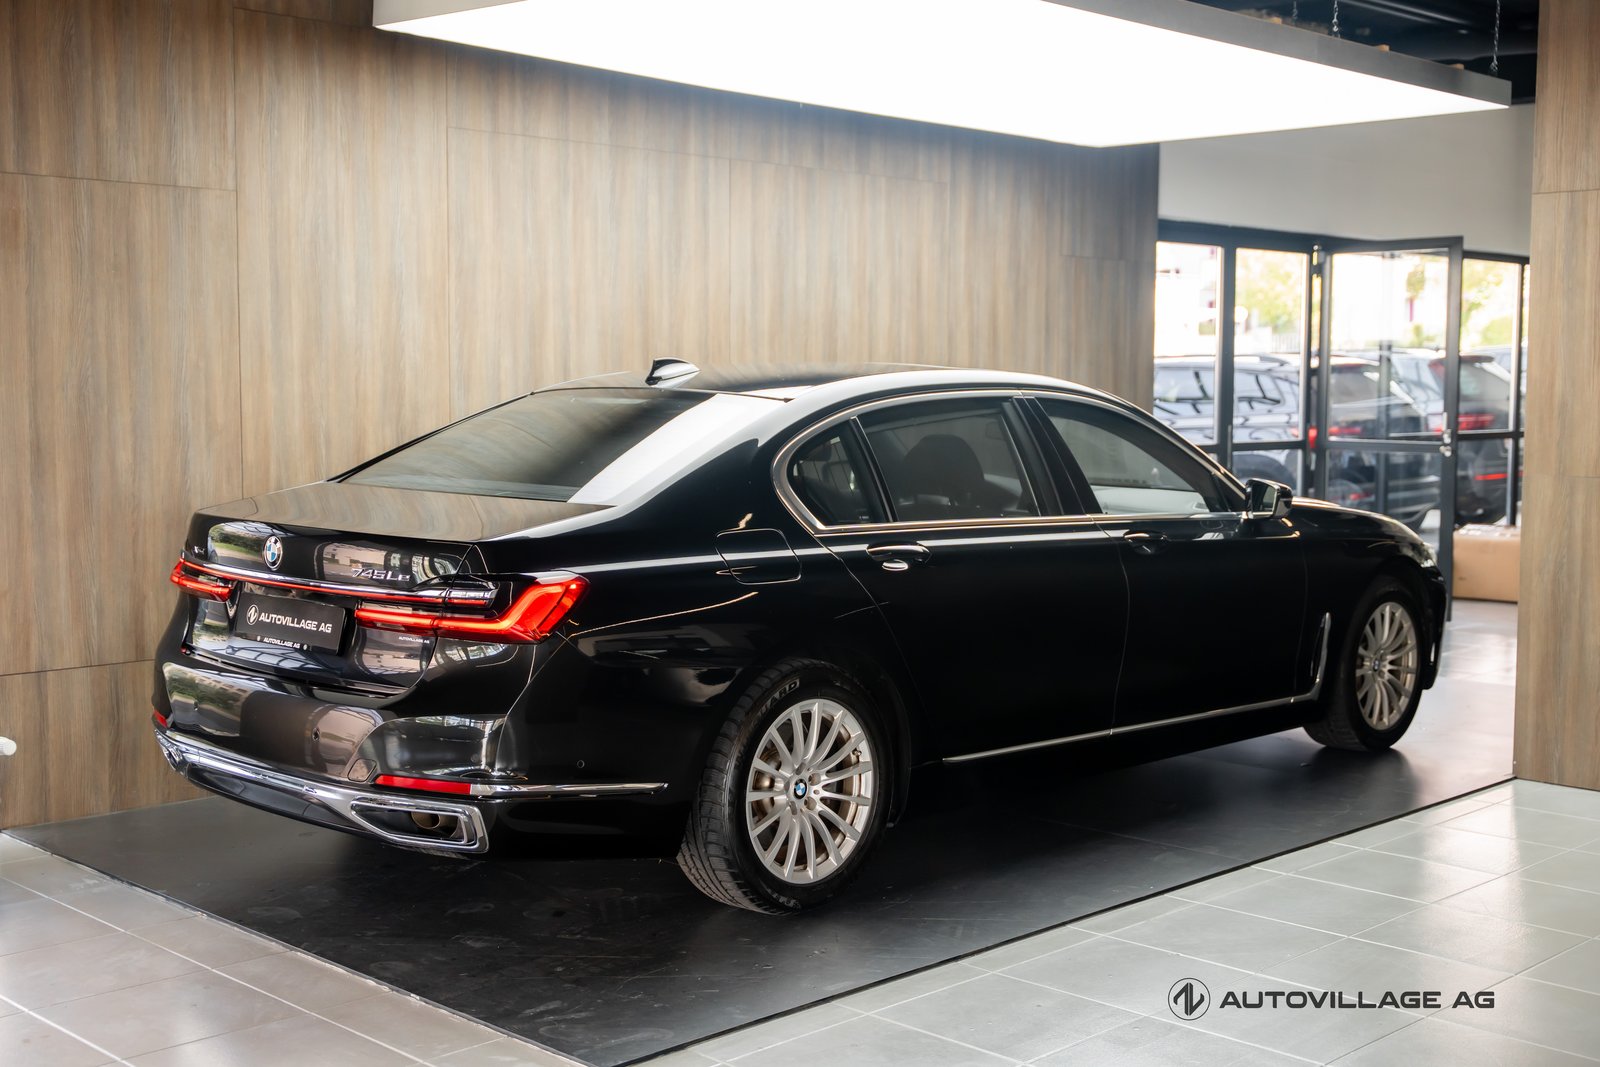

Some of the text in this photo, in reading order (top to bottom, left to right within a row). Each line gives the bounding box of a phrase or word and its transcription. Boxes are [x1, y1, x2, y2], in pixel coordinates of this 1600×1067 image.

[258, 612, 333, 634] AUTOVILLAGE AG
[263, 637, 293, 648] AUTOVILLAGE
